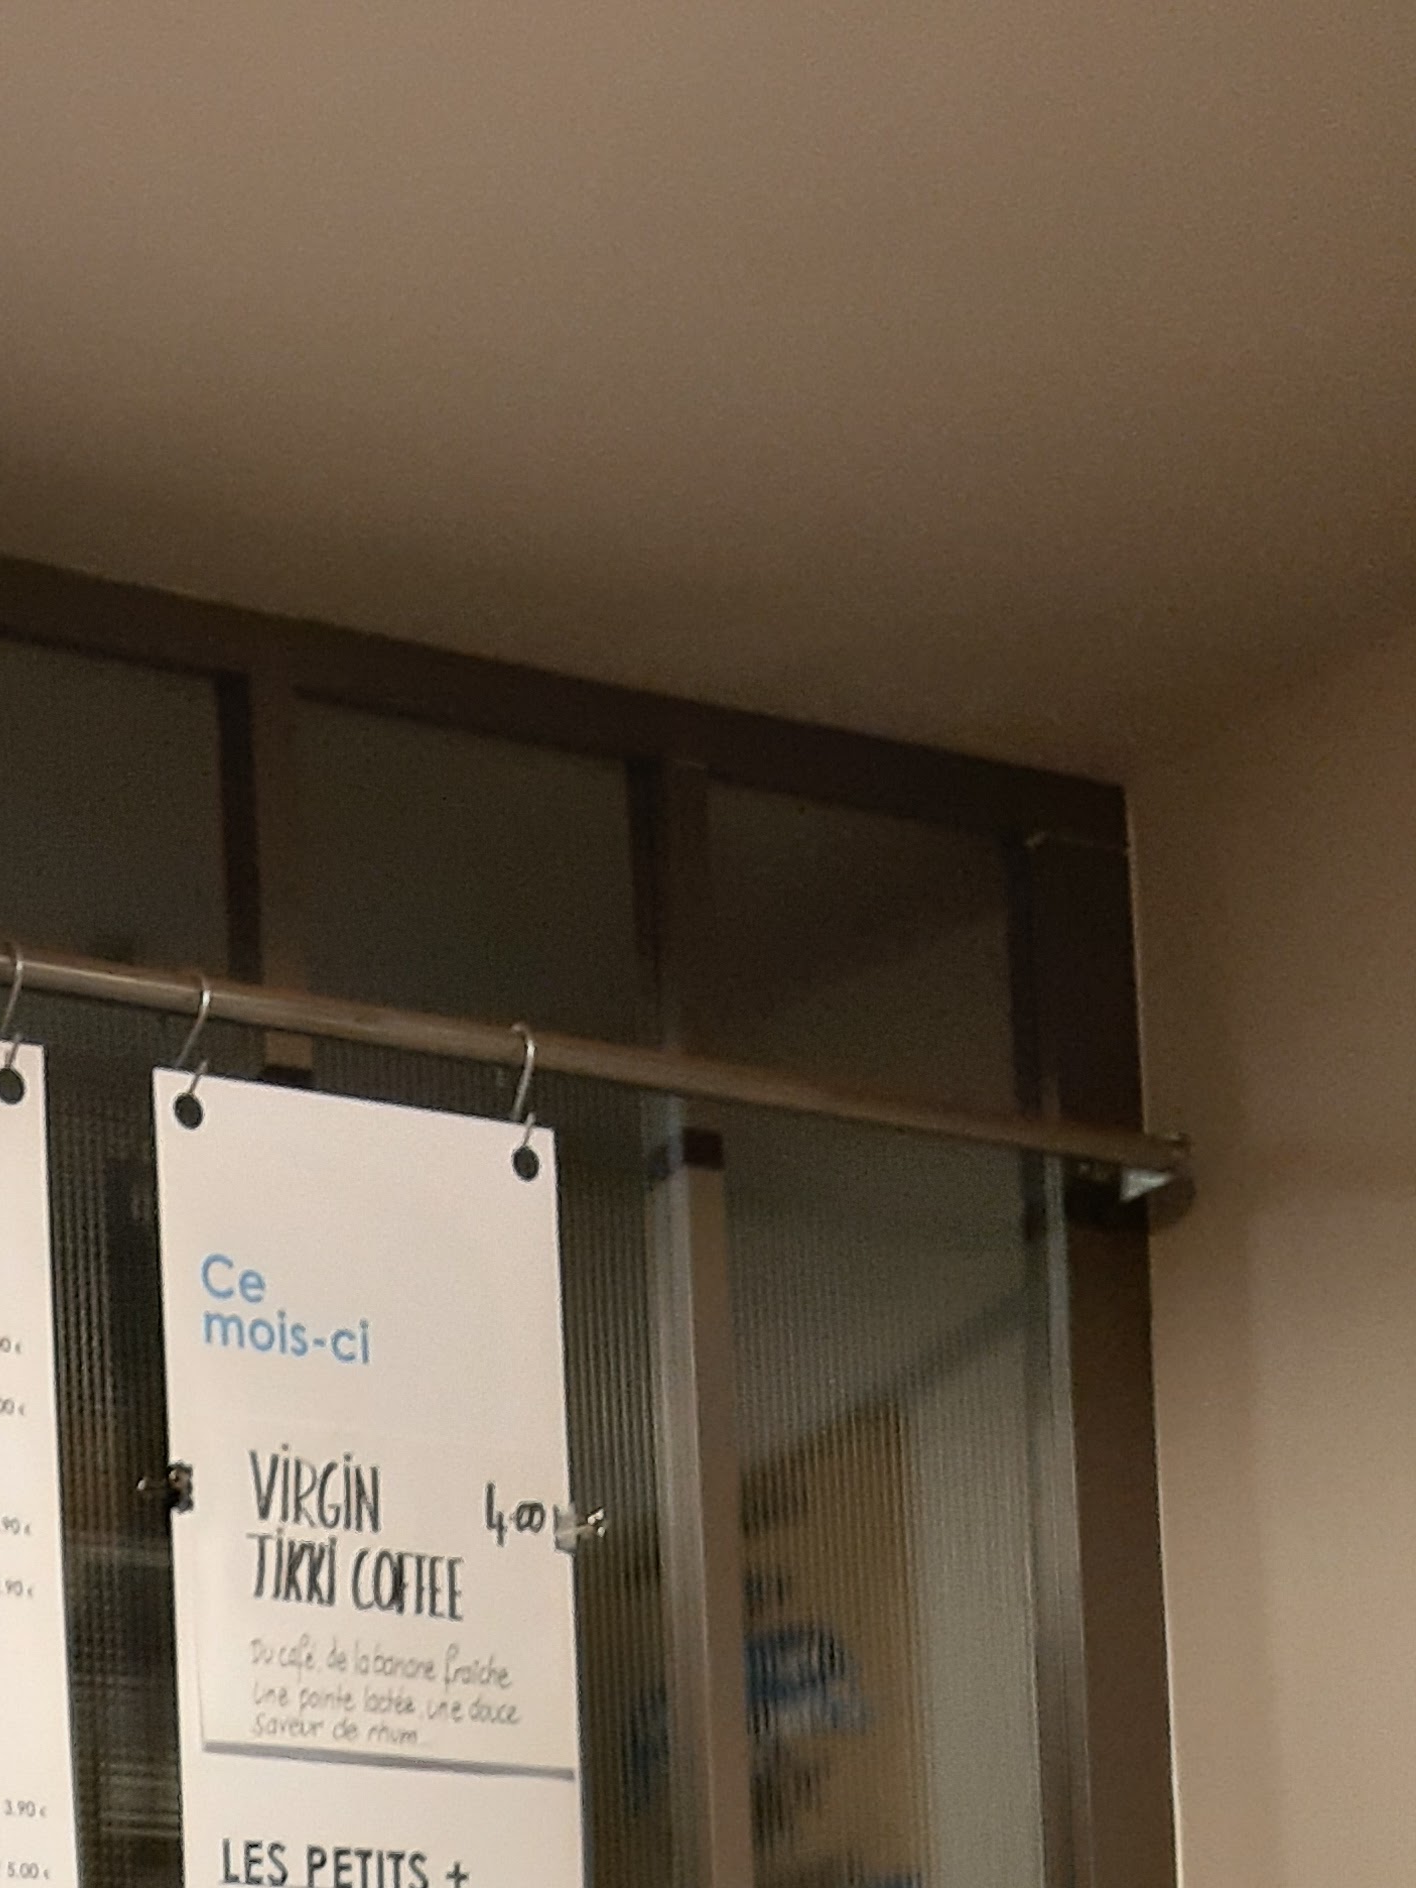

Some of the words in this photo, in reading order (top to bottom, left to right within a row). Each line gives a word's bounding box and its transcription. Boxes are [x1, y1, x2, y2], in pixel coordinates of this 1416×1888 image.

[202, 1254, 265, 1301] Ce
[203, 1311, 370, 1364] mois-ci
[222, 1838, 287, 1887] LES
